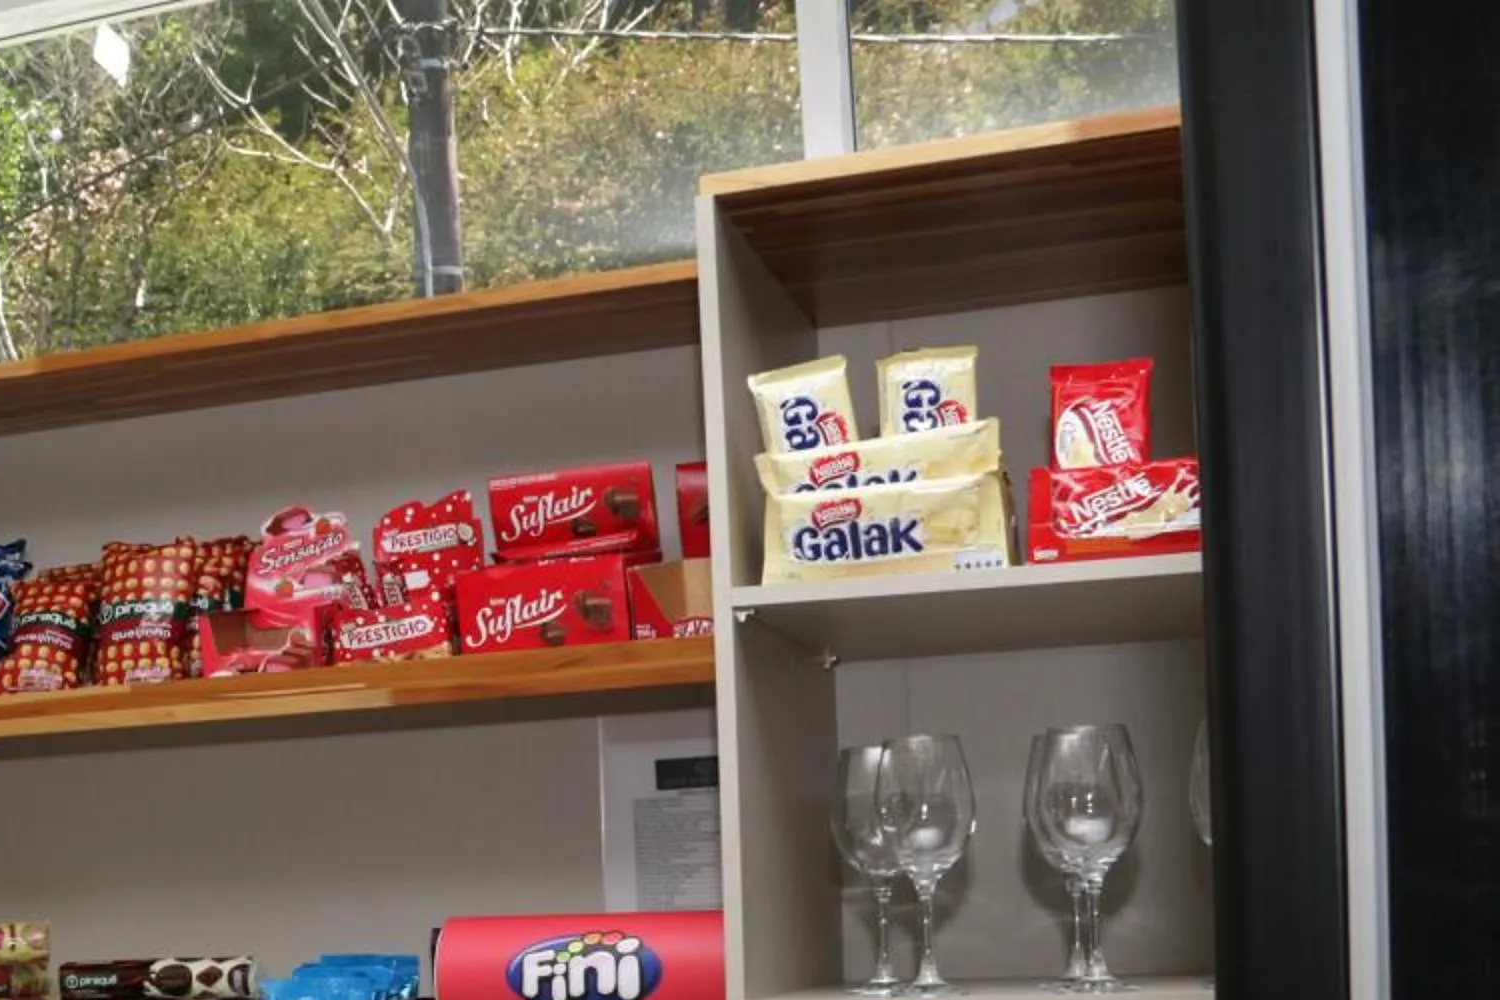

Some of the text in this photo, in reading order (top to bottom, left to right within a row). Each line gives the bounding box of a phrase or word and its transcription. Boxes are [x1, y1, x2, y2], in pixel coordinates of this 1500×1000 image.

[501, 486, 593, 541] Suflair
[794, 517, 924, 562] Galak
[466, 589, 564, 647] Suflair
